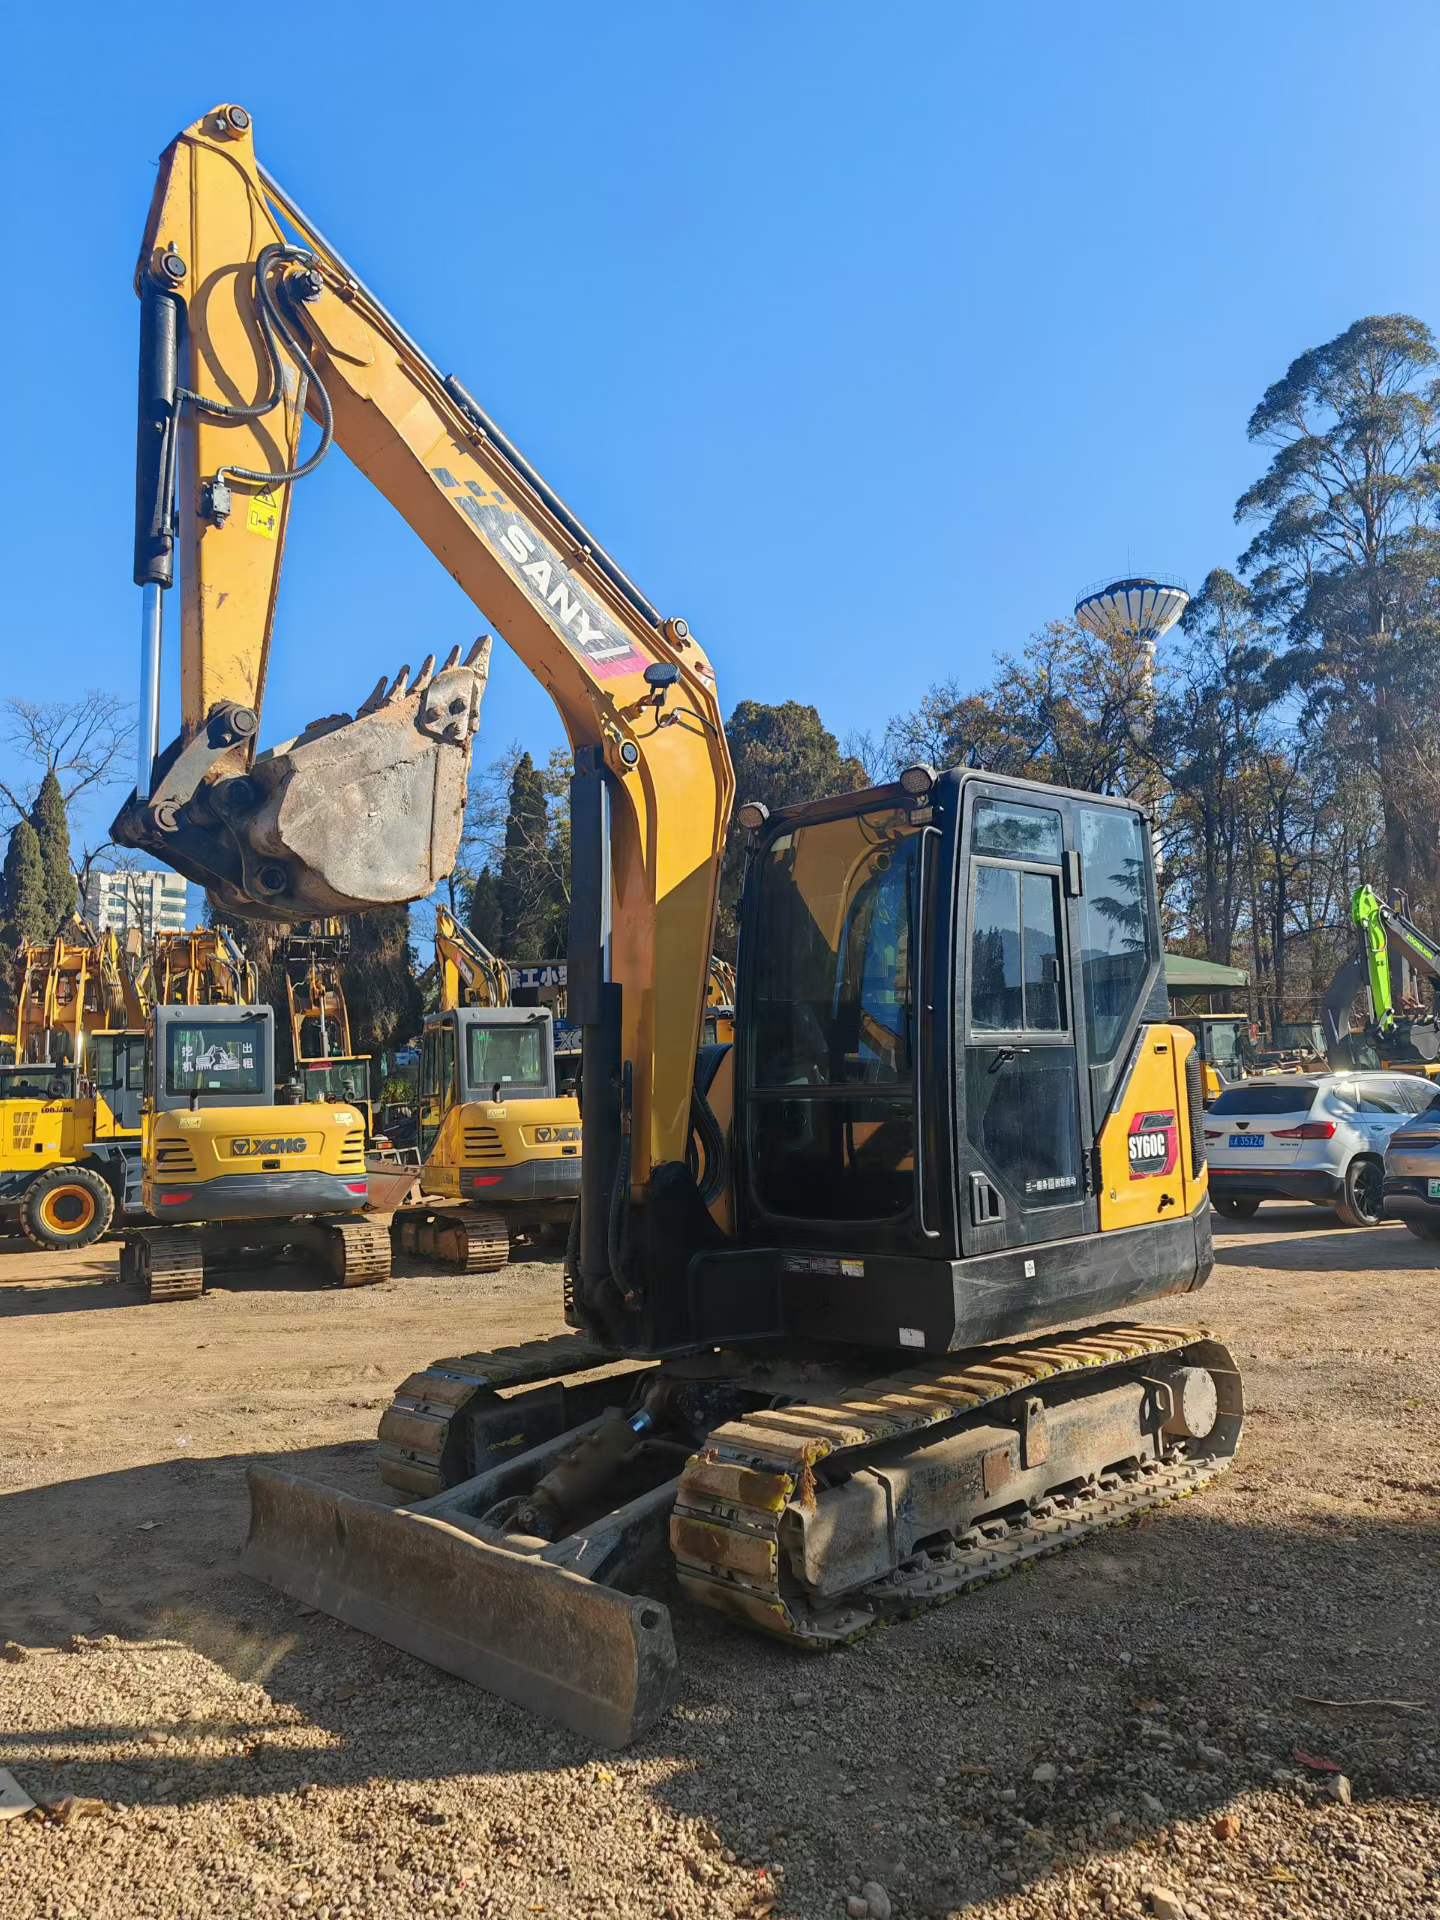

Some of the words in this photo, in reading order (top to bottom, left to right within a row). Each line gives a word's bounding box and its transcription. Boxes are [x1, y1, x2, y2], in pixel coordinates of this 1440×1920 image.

[500, 525, 606, 646] SANY
[251, 1137, 307, 1155] XCMG
[1129, 1133, 1165, 1159] SY60C
